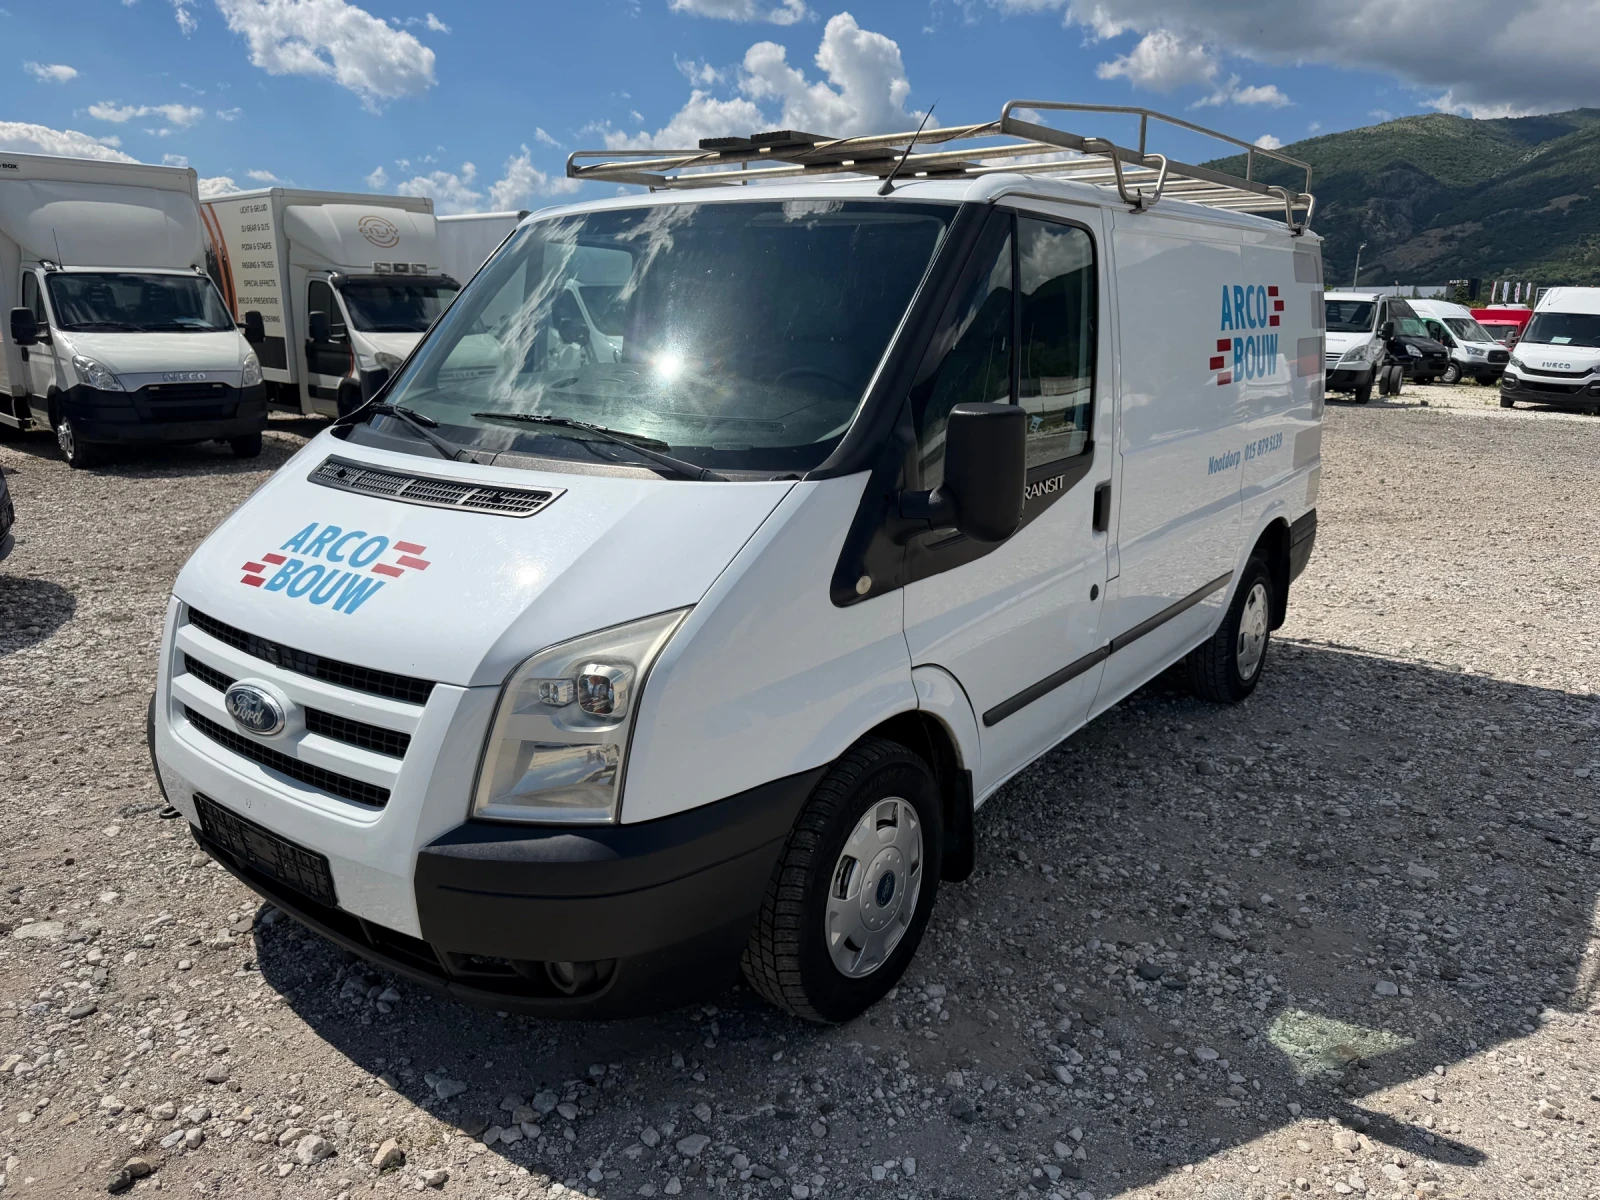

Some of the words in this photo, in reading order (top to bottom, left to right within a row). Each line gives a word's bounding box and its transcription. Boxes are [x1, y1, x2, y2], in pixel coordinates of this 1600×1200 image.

[1221, 284, 1267, 331] ARCO
[163, 372, 207, 382] IVECO
[1233, 333, 1278, 382] BOUW
[1541, 361, 1571, 369] IVECO
[1208, 449, 1241, 476] Nootdorp
[1244, 441, 1256, 461] 015
[1257, 436, 1268, 456] 879
[1025, 474, 1065, 500] RANSIT
[279, 522, 389, 568] ARCO
[263, 558, 386, 615] BOUW
[233, 693, 265, 725] Ford
